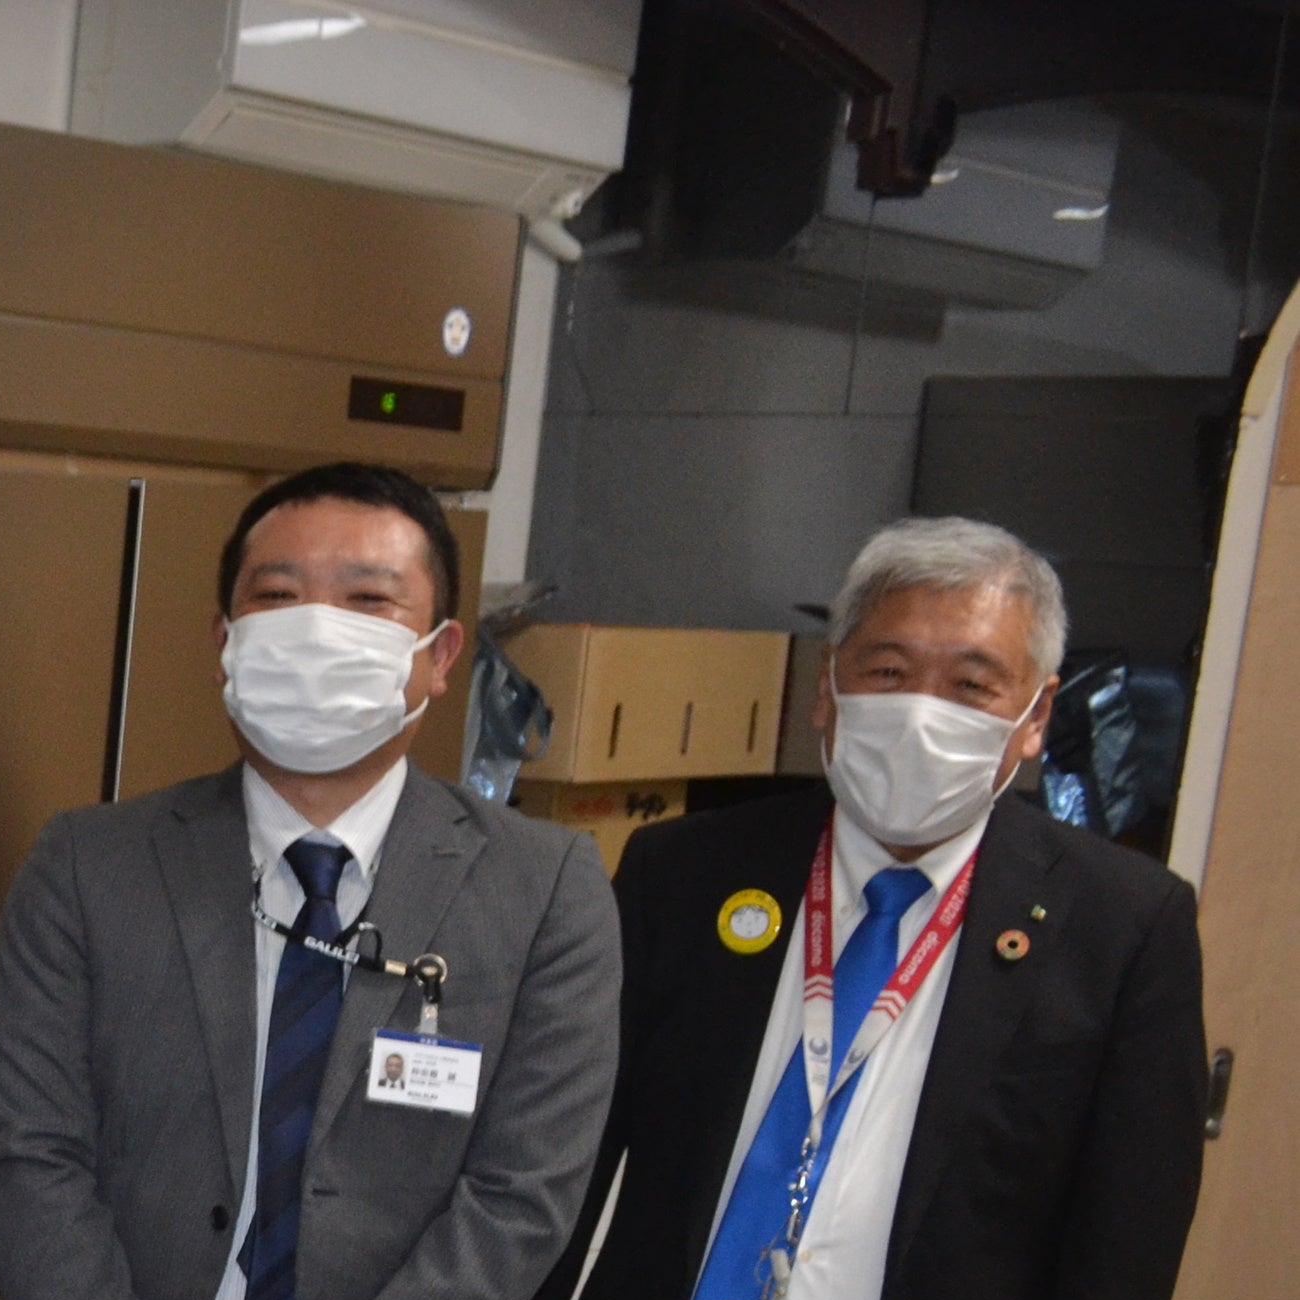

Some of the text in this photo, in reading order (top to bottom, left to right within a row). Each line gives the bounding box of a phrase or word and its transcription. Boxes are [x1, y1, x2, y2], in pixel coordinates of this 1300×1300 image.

[303, 935, 360, 965] GALILEI
[810, 910, 824, 966] docomo
[897, 930, 940, 985] docomo
